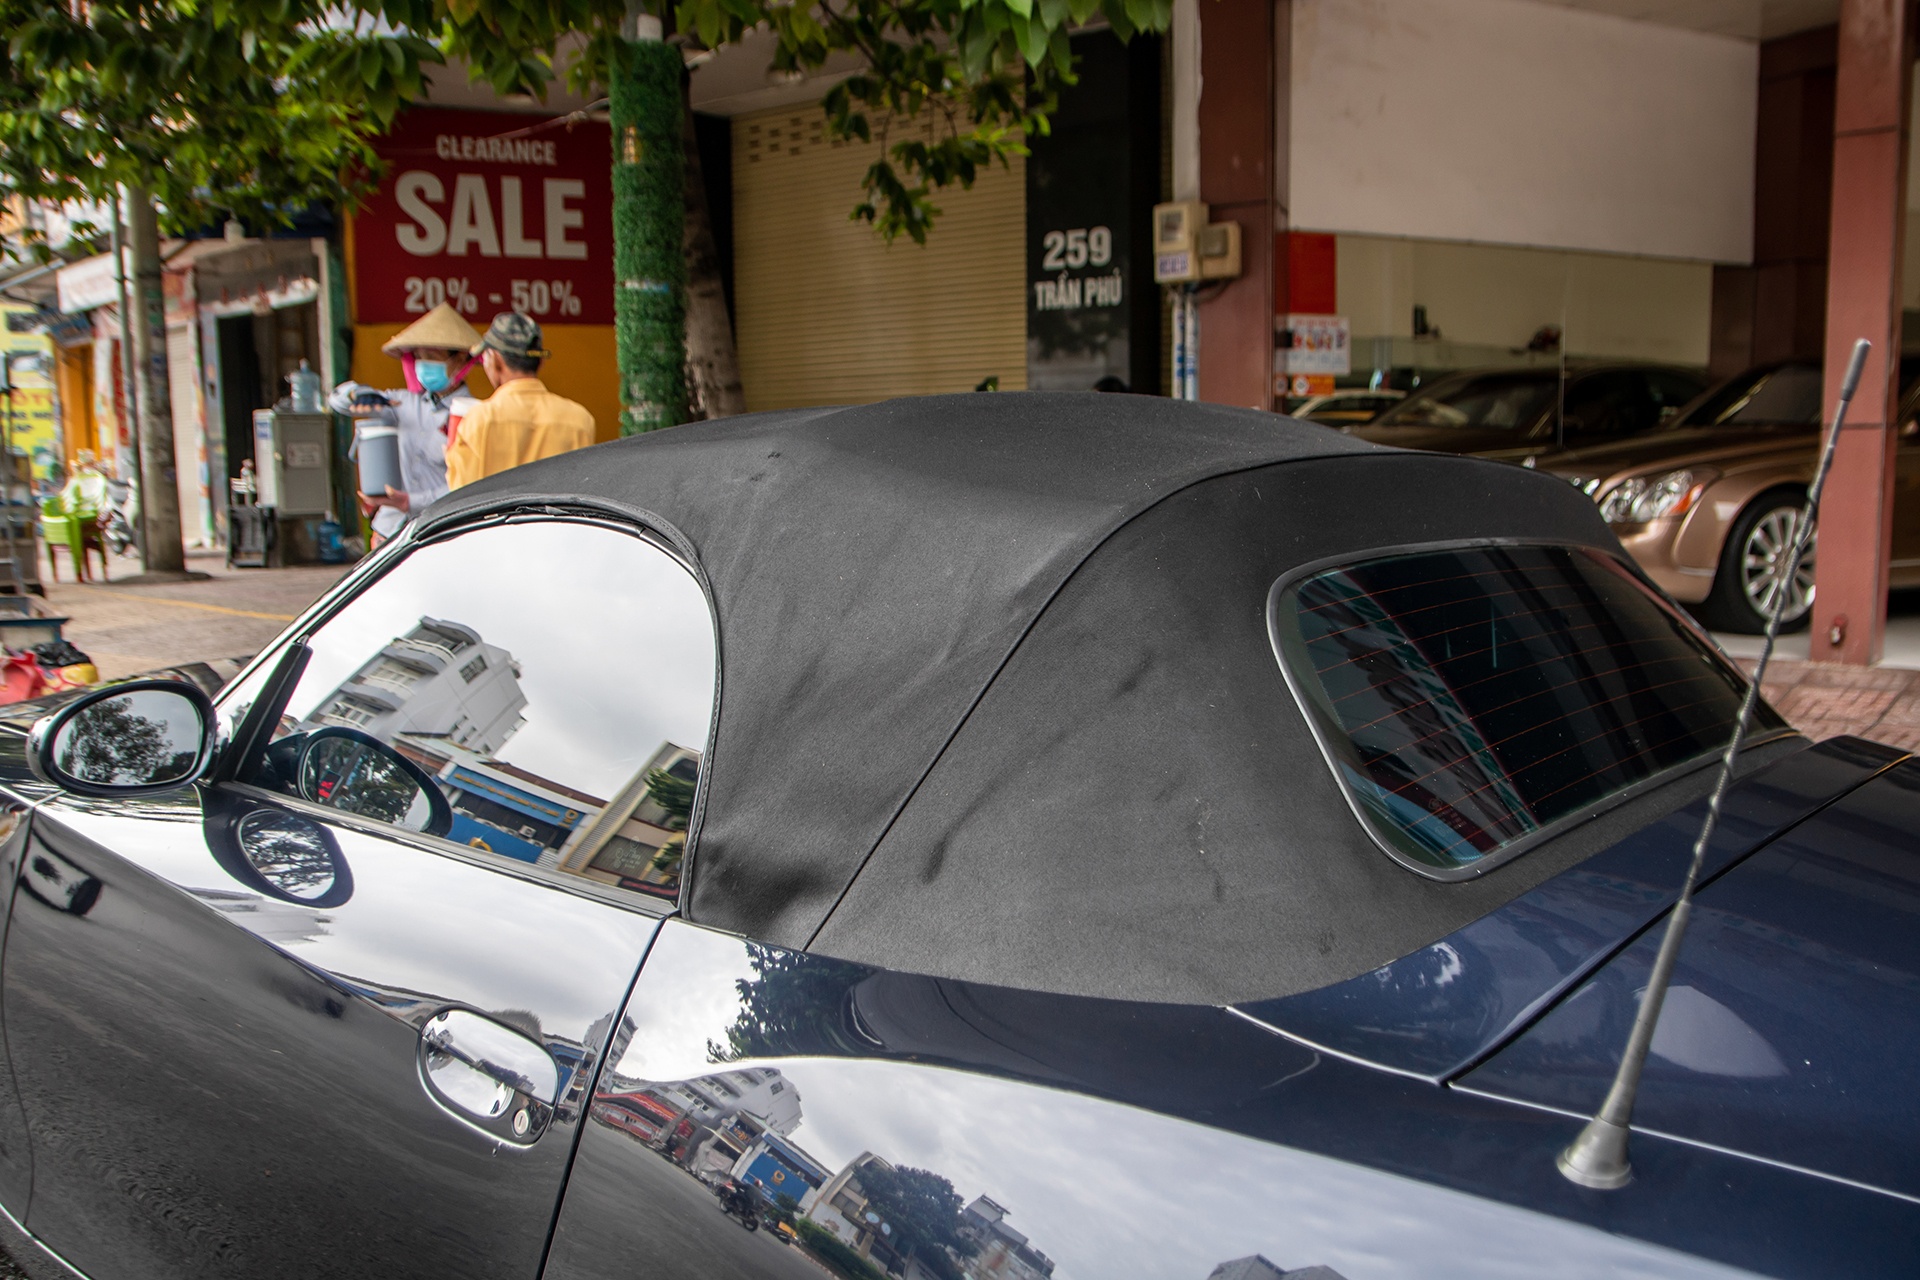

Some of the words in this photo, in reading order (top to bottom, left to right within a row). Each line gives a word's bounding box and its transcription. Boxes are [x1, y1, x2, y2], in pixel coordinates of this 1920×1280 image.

[437, 135, 557, 165] CLEARANCE
[394, 170, 588, 260] SALE
[1043, 225, 1112, 271] 259
[404, 276, 479, 314] 20%
[511, 279, 582, 316] 50%
